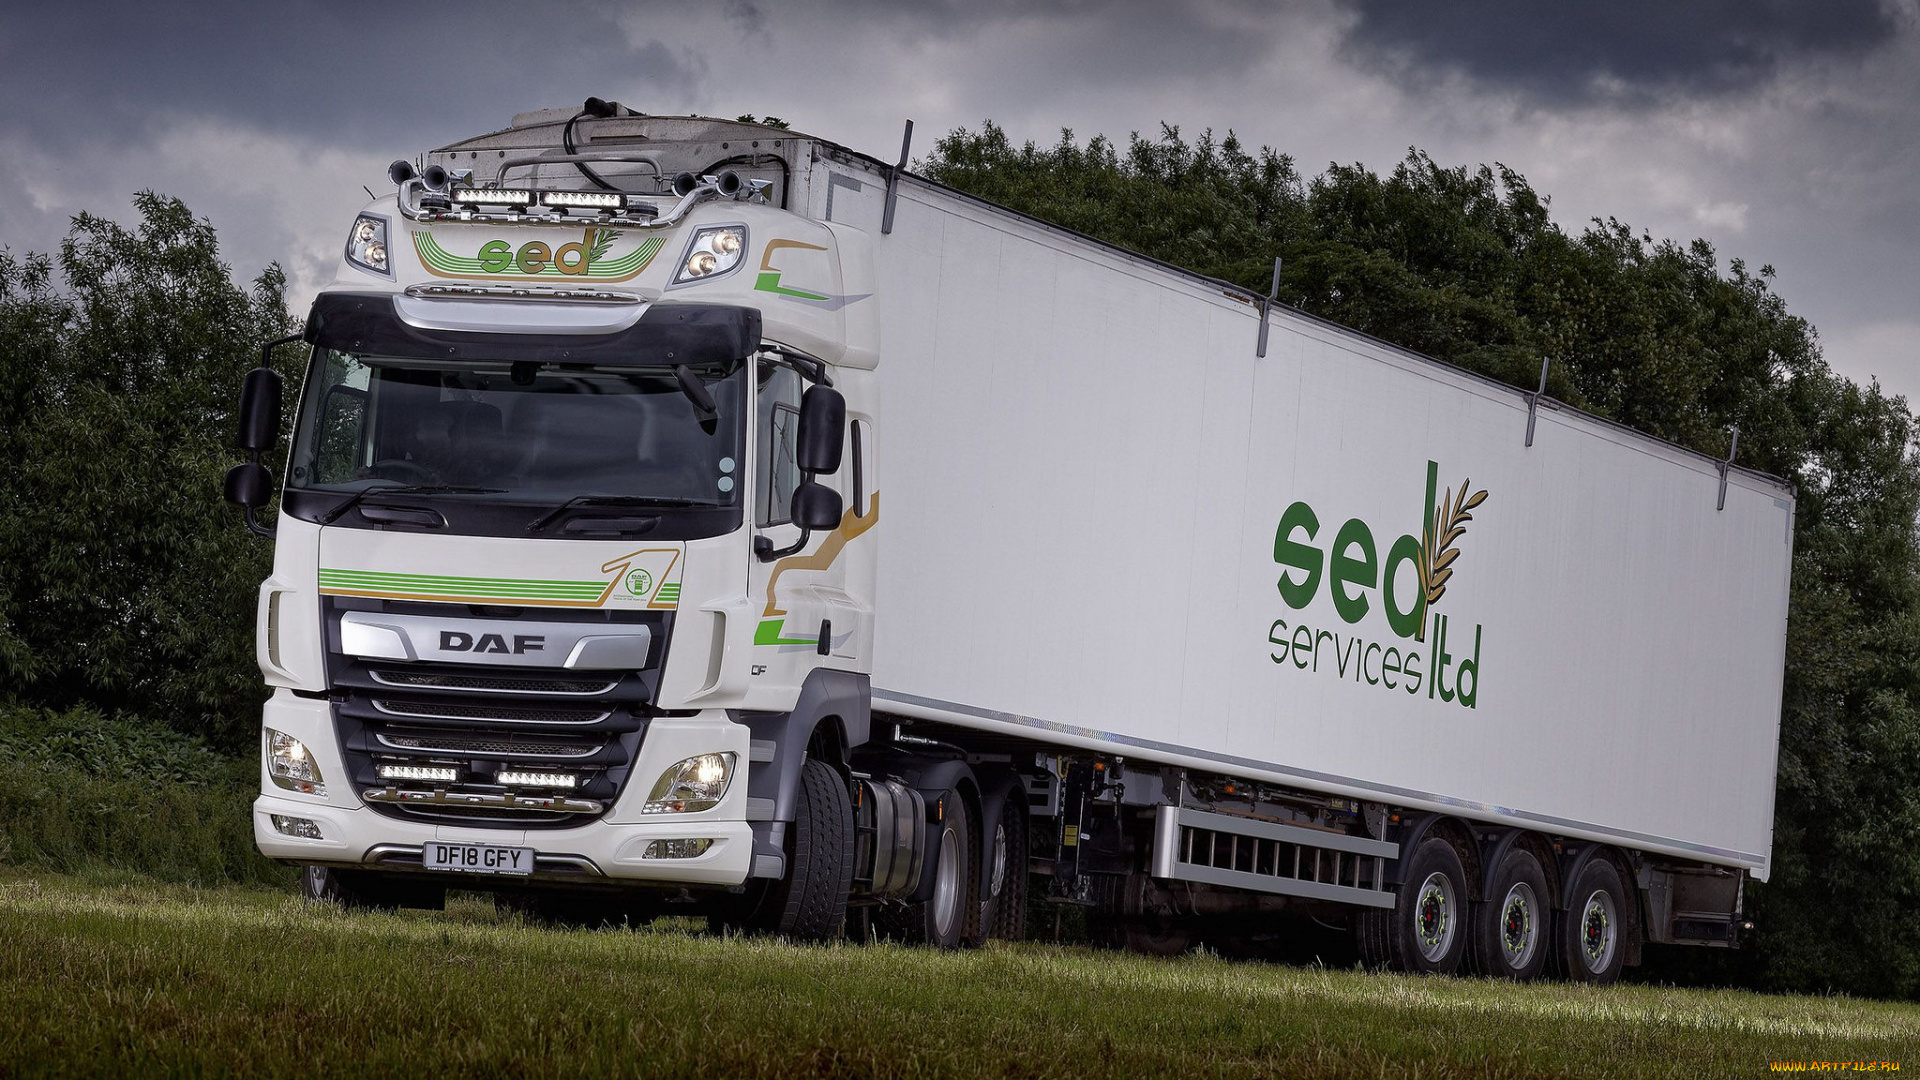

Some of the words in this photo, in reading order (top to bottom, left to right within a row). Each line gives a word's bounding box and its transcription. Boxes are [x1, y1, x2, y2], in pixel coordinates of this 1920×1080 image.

[478, 228, 595, 275] sed
[1273, 459, 1438, 643] sed
[439, 630, 545, 655] DAF
[1268, 618, 1422, 695] services
[1428, 612, 1482, 709] ltd
[436, 845, 478, 866] DF18
[484, 848, 522, 869] GFY
